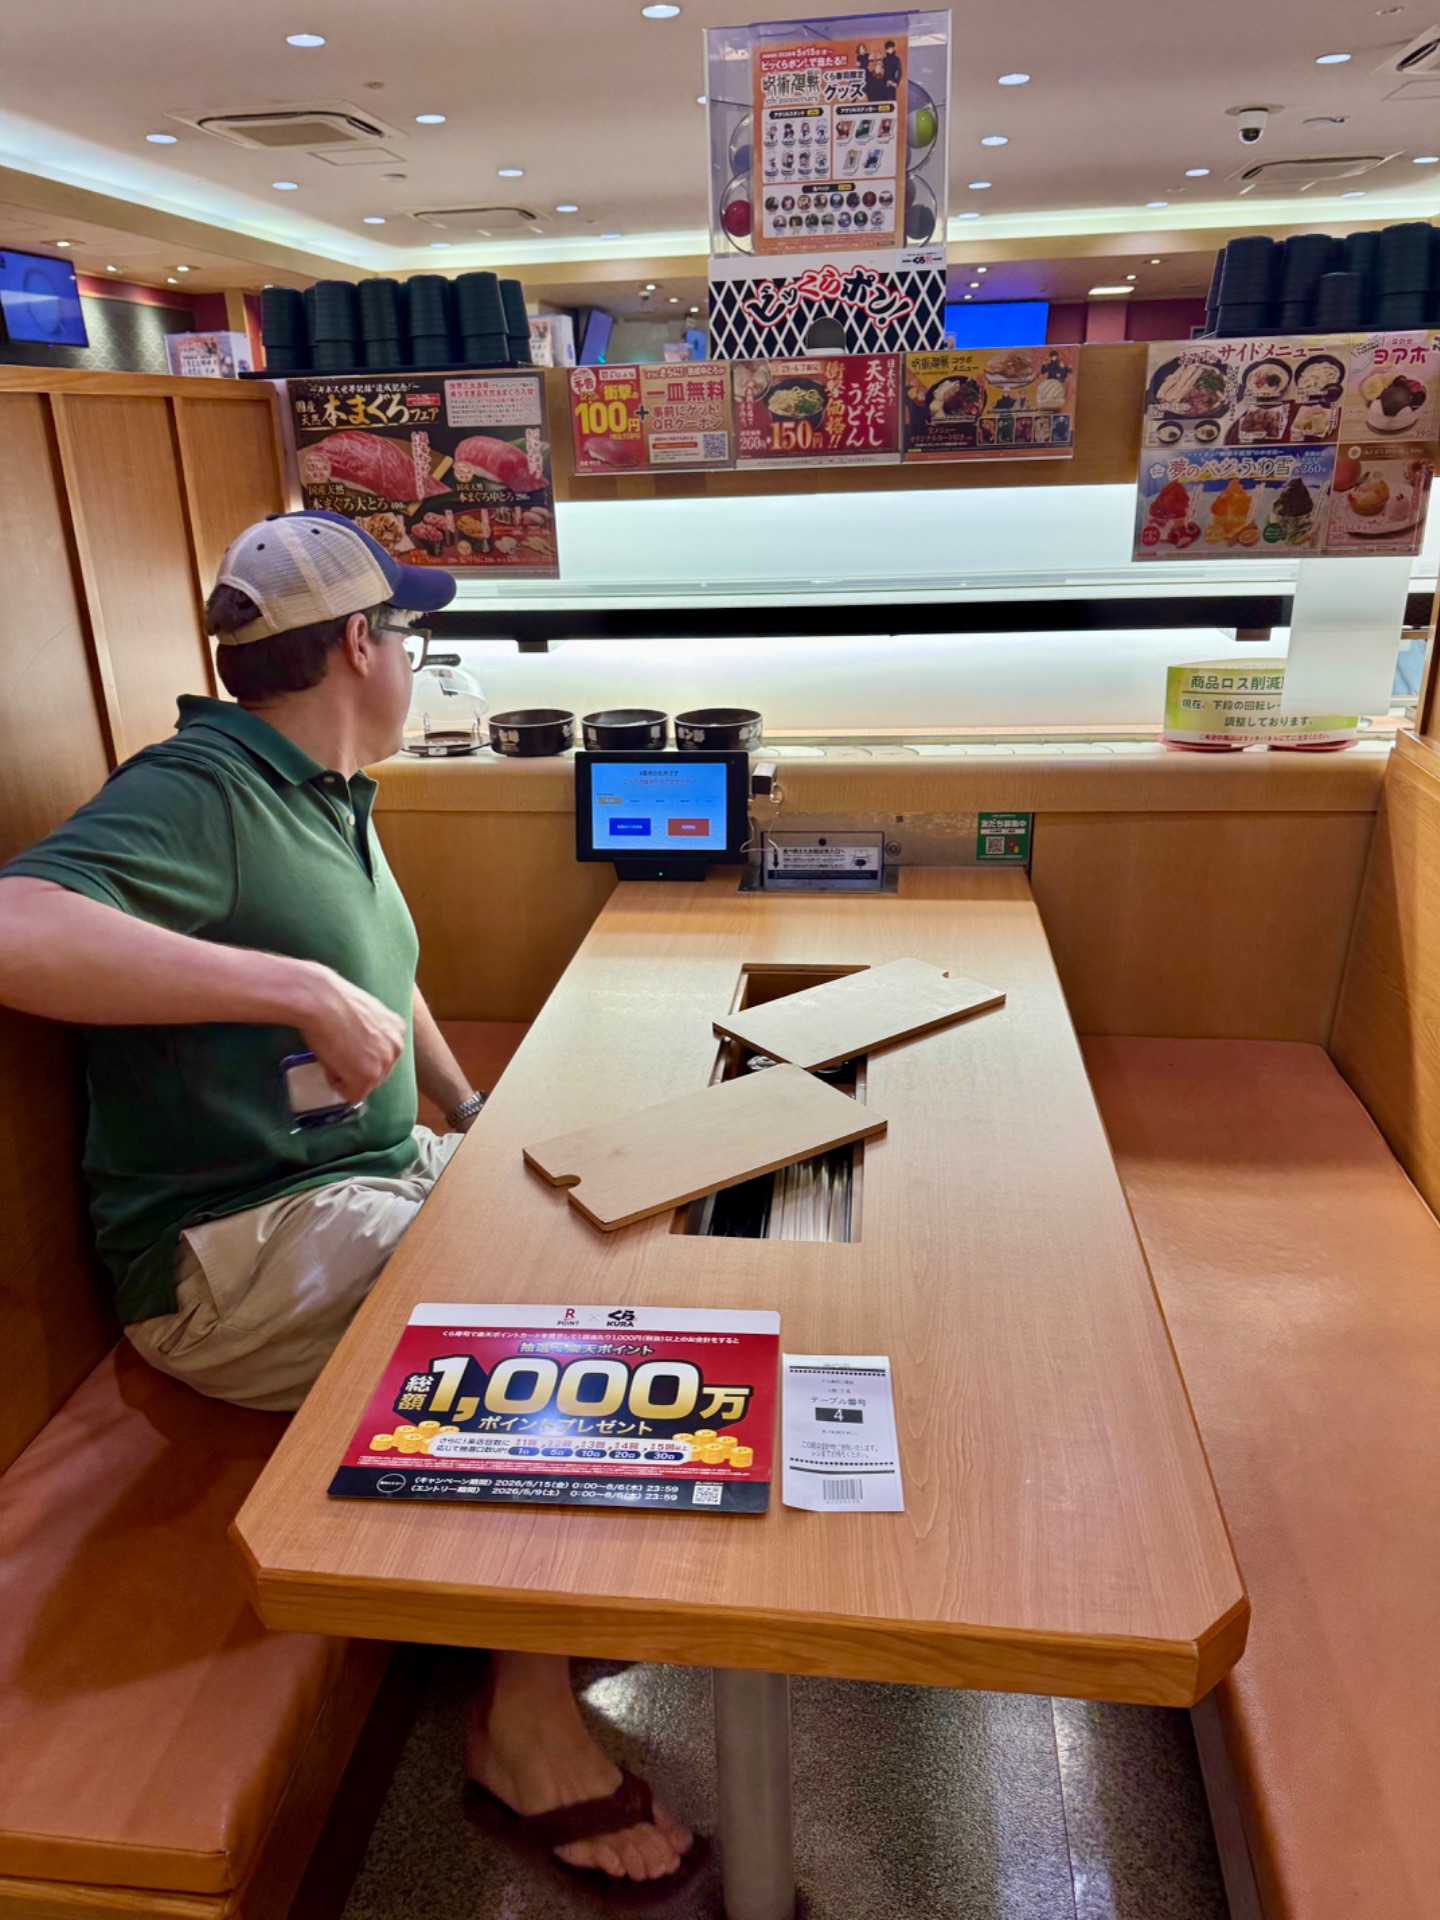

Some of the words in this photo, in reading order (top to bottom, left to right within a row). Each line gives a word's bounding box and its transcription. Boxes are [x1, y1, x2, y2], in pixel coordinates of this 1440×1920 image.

[825, 82, 864, 100] グッズ
[1218, 343, 1325, 361] サイドメニュー
[952, 356, 973, 365] コラボ
[952, 365, 979, 373] メニュー
[646, 379, 726, 402] 一皿無料
[322, 393, 410, 427] 本まぐろ
[864, 360, 886, 446] 天然だし
[409, 407, 439, 422] フェア
[574, 401, 641, 435] 100円
[653, 404, 721, 418] 事前にゲット!
[846, 383, 864, 447] うどん
[653, 416, 723, 431] QRクーポン
[770, 420, 824, 450] 150円
[1190, 675, 1285, 691] 商品ロス削減
[1223, 716, 1314, 728] 調整しております。
[564, 1308, 576, 1319] R
[608, 1309, 636, 1322] くら
[556, 1319, 580, 1327] POINT
[519, 1341, 655, 1356] 抽選で楽天ポイント
[398, 1374, 435, 1411] 総額
[428, 1355, 751, 1422] 1,000万
[811, 1396, 867, 1408] テーブル番号
[833, 1408, 844, 1422] 4
[477, 1415, 654, 1436] ポイントプレゼント
[644, 1492, 679, 1502] 23:59
[646, 1485, 680, 1494] 23:59
